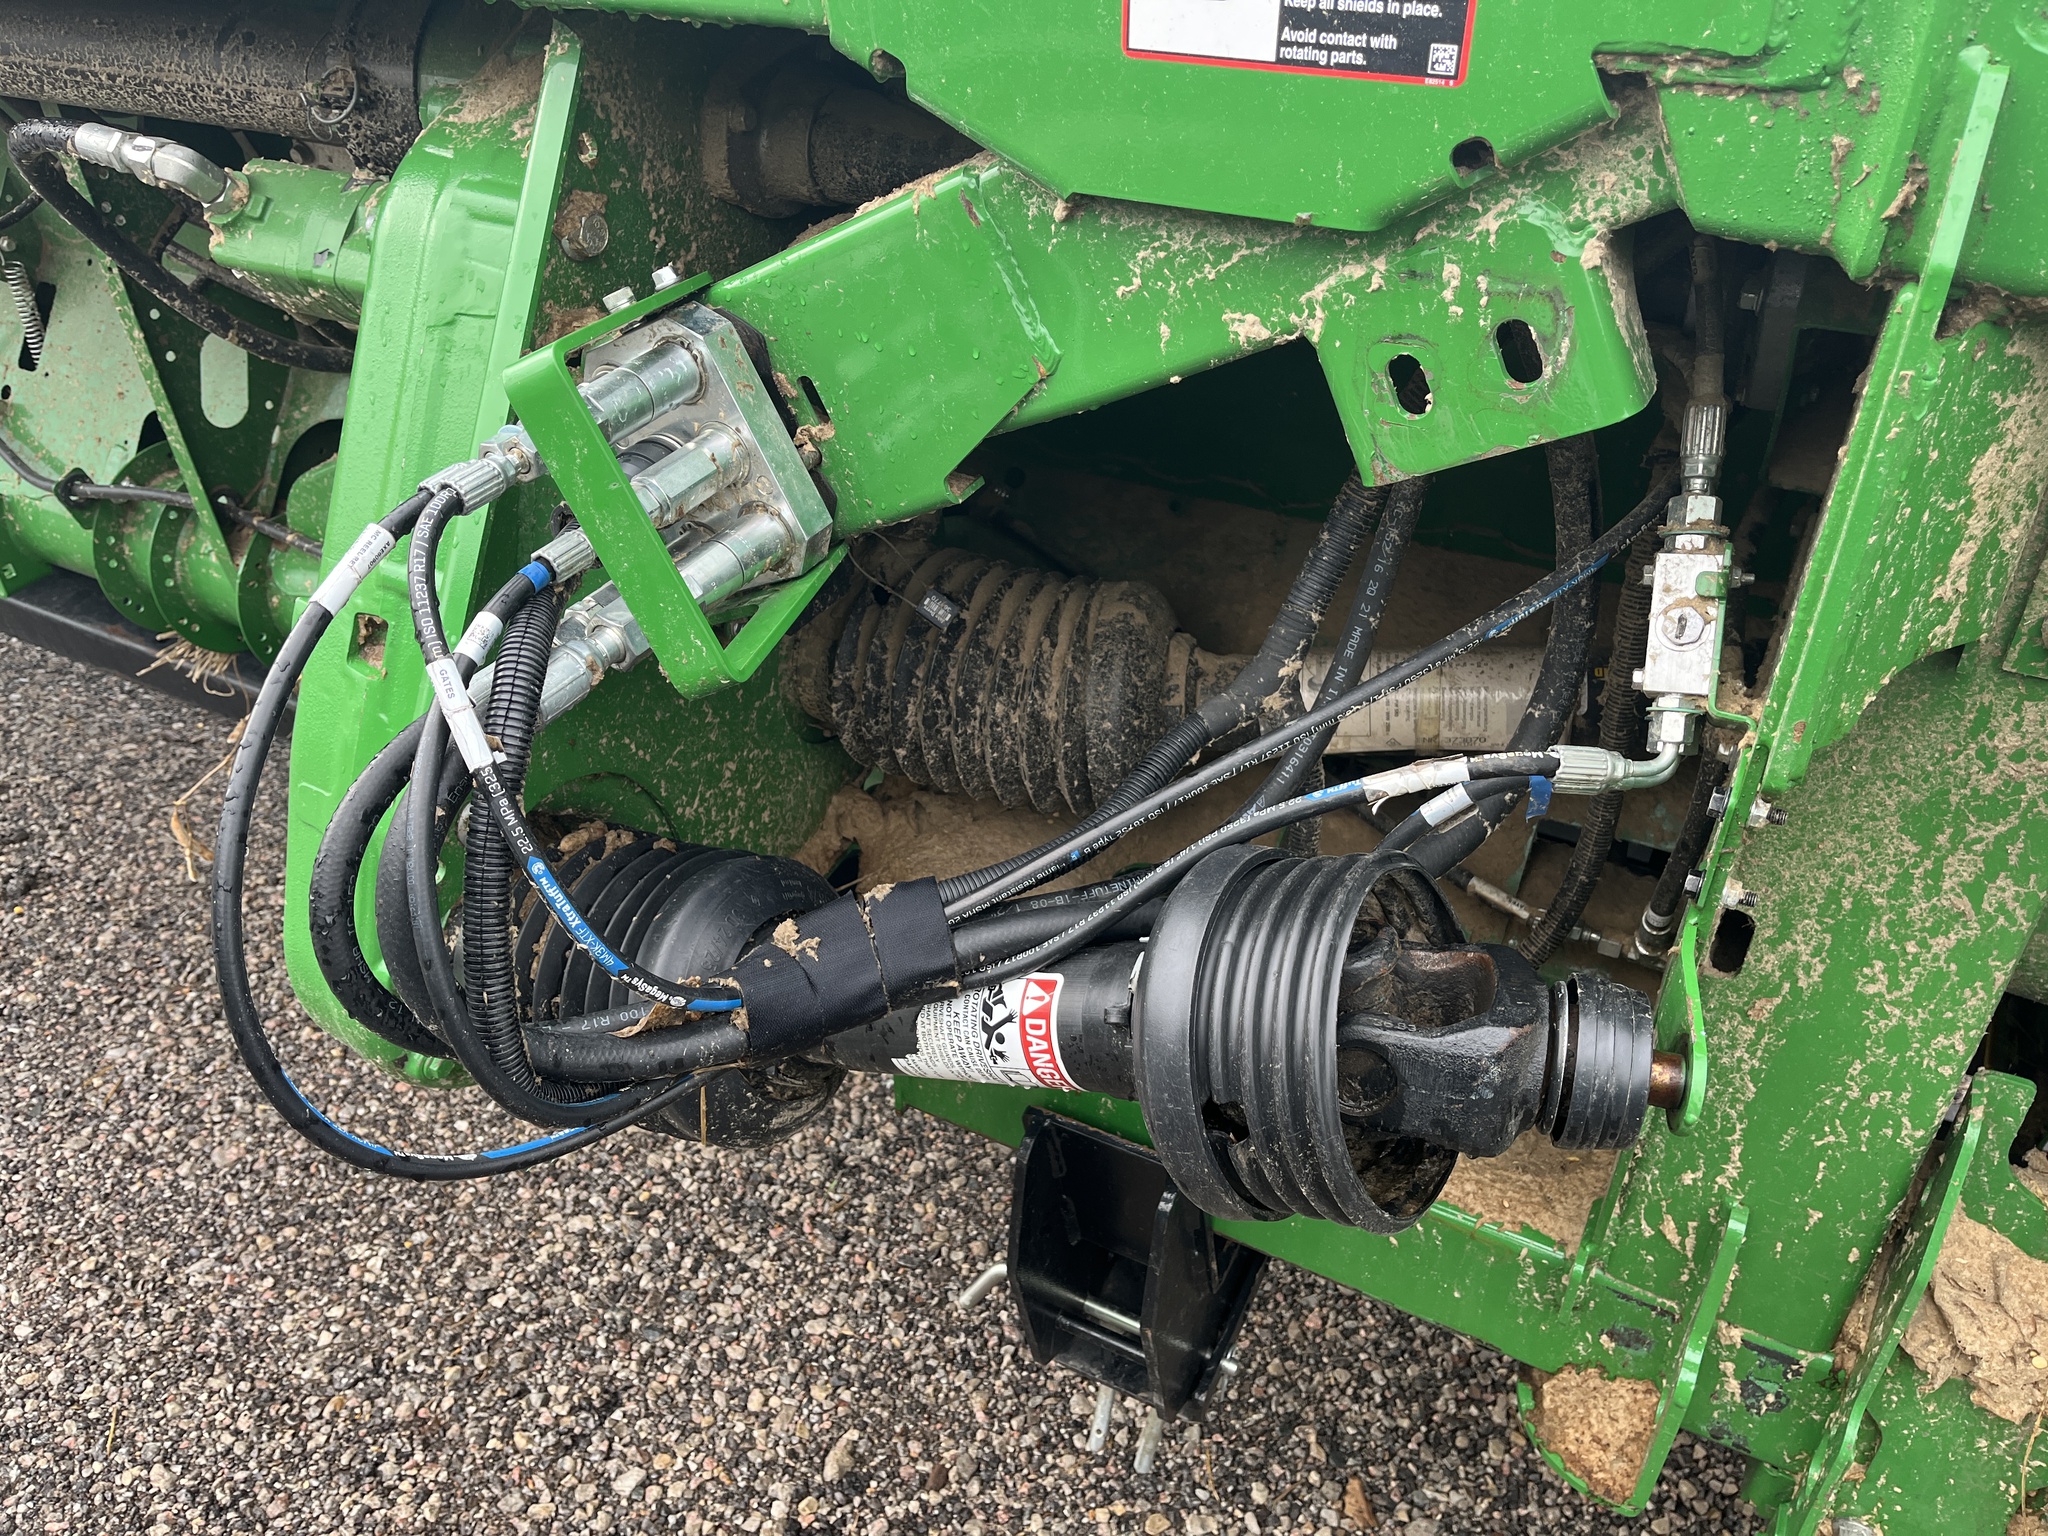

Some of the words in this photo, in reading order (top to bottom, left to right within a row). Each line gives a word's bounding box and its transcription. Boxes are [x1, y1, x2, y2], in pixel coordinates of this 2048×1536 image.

[1318, 0, 1335, 10] all
[1337, 0, 1384, 14] shields
[1387, 0, 1400, 14] in
[1402, 0, 1443, 18] place.
[1280, 26, 1318, 44] Avoid
[1319, 31, 1368, 48] contact
[1369, 33, 1398, 50] with
[1279, 45, 1328, 66] rotating
[1330, 49, 1367, 66] parts.
[417, 515, 432, 539] SAE
[412, 547, 428, 574] R17
[412, 575, 430, 614] 11237
[421, 618, 437, 641] ISO
[1341, 624, 1363, 659] MADE
[438, 668, 456, 700] GATES
[1333, 664, 1348, 682] IN
[480, 766, 504, 800] [325
[499, 798, 518, 825] MPa
[512, 826, 533, 855] 22.5
[1090, 832, 1114, 850] Type
[1035, 859, 1066, 881] Flame
[538, 876, 580, 929] XtraTuff™
[990, 876, 1036, 905] Resistant
[961, 899, 991, 920] MSHA
[576, 929, 615, 967] 4M3K-XTF
[349, 943, 375, 984] MSHA
[931, 1002, 940, 1042] QUIPMENT
[937, 1000, 946, 1041] RIVESHAFT
[951, 1009, 962, 1043] KEEP
[944, 1019, 958, 1058] OPERATE
[963, 1029, 971, 1045] CAN
